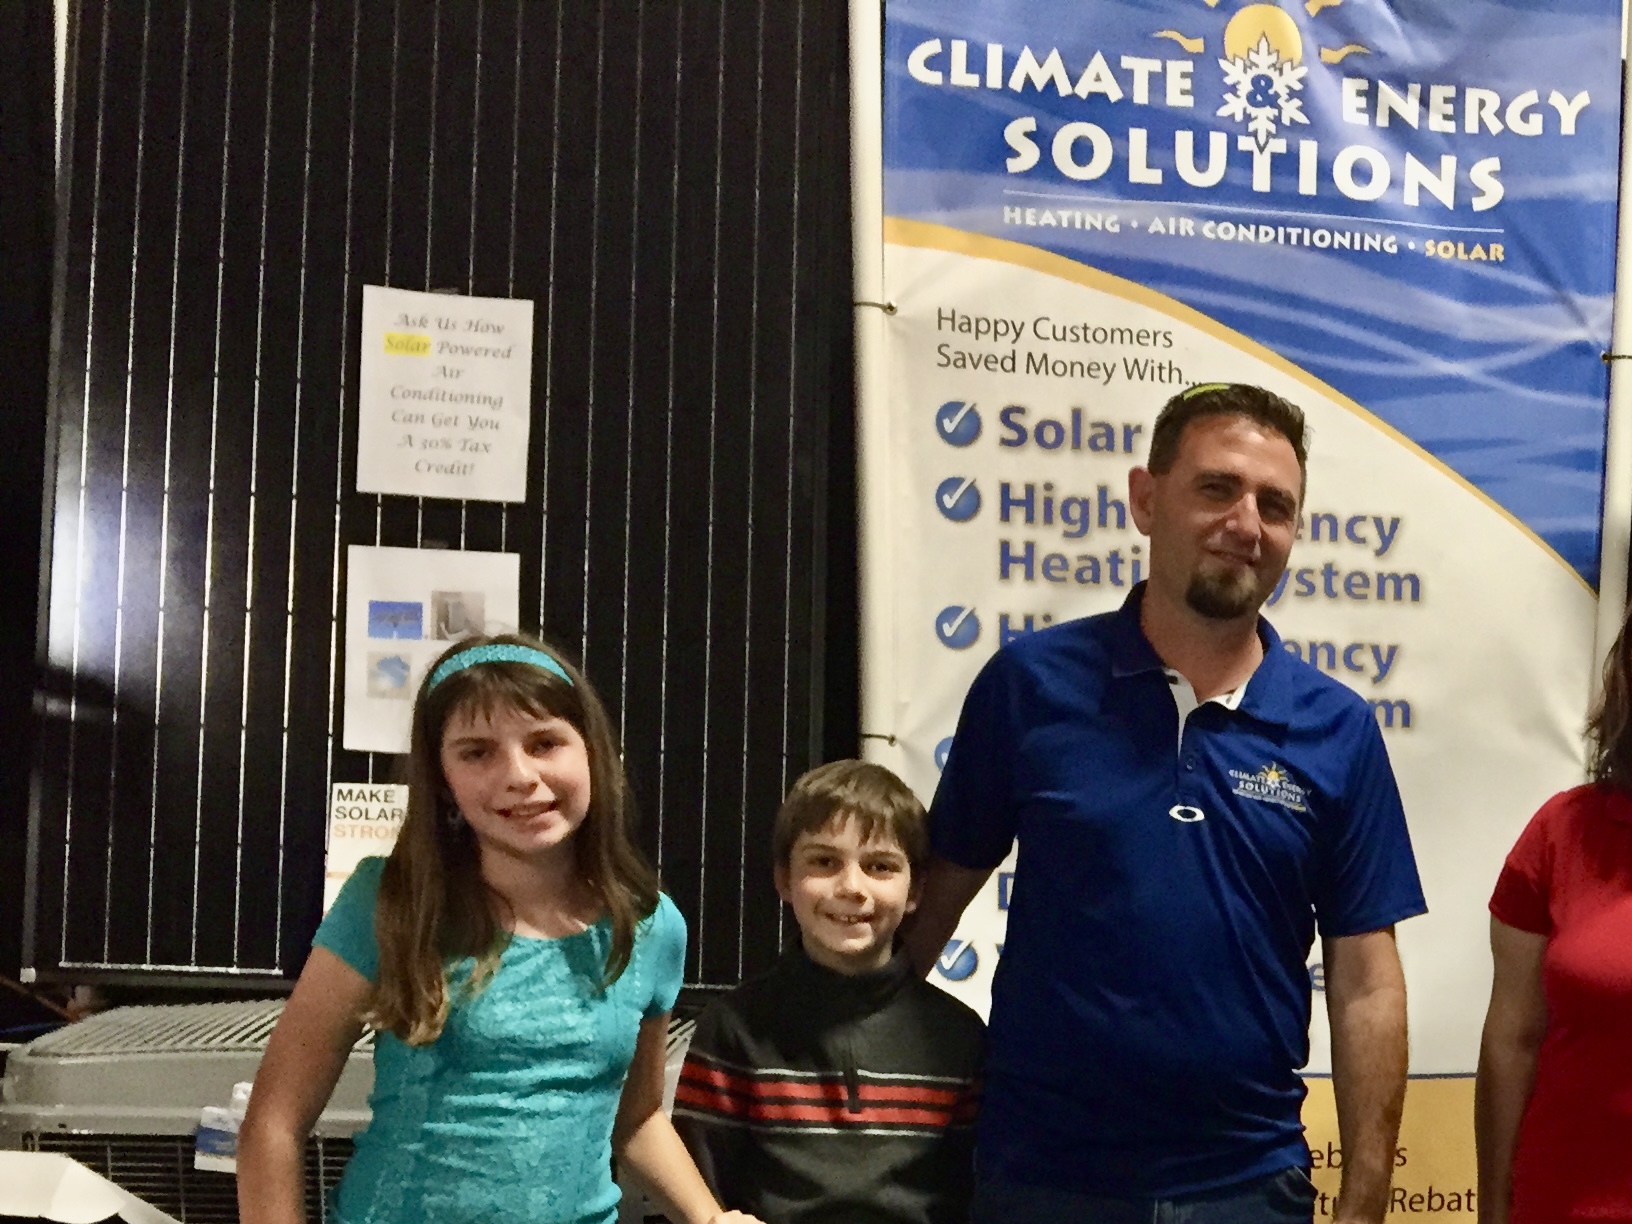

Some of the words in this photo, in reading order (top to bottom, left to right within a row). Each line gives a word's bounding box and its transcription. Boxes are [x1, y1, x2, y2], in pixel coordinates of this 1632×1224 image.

[907, 38, 1196, 108] CLIMATE
[1341, 78, 1591, 137] ENERGY
[1003, 116, 1505, 213] SOLUTIONS
[1003, 206, 1121, 234] HEATING
[1147, 214, 1196, 238] AIR
[1202, 219, 1398, 254] CONDITIONING
[1424, 239, 1505, 262] SOLAR
[394, 313, 429, 328] Ask
[937, 307, 1025, 344] Happy
[1033, 316, 1174, 349] Customers
[436, 341, 514, 359] Powered
[937, 343, 1017, 373] Saved
[1025, 351, 1117, 386] Money
[390, 385, 504, 410] Conditioning
[391, 409, 425, 424] Can
[1000, 405, 1143, 455] Solar
[1000, 482, 1128, 539] High
[334, 805, 404, 821] SOLAR
[336, 788, 395, 803] MAKE
